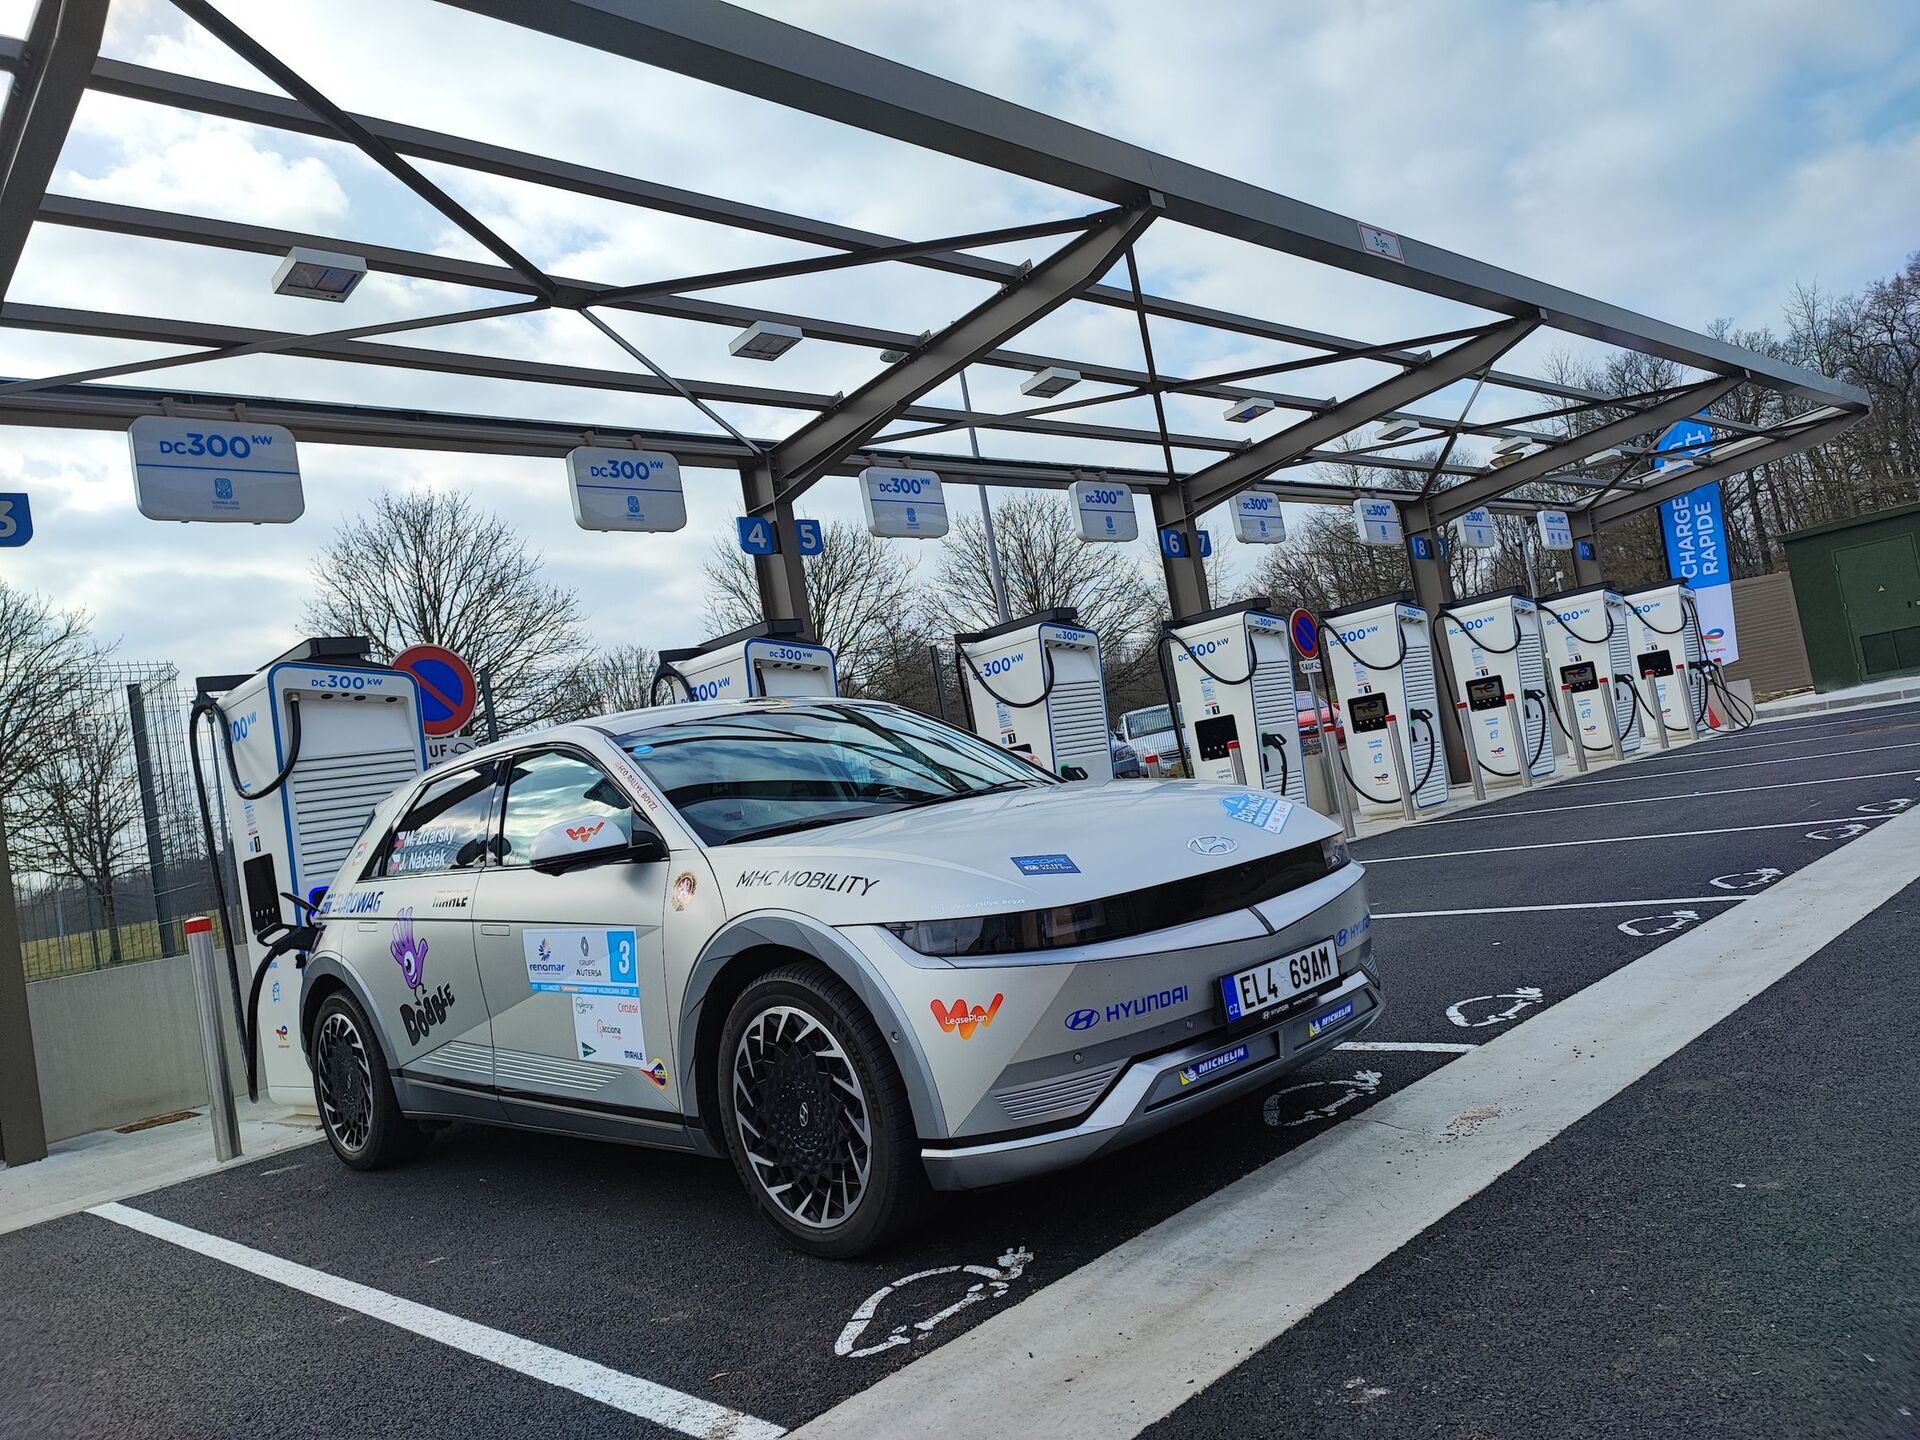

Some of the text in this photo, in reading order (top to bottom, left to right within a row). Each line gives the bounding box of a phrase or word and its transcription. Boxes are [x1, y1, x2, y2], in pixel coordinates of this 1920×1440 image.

[748, 522, 767, 549] 4
[800, 524, 817, 549] 5
[1169, 533, 1180, 553] 6
[1197, 535, 1205, 552] 7
[1672, 496, 1698, 579] CHARGE
[1694, 501, 1719, 577] RAPIDE
[1418, 541, 1426, 556] 8
[429, 744, 447, 757] UF
[736, 870, 880, 897] MHC MOBILITY
[530, 963, 565, 972] renomar
[618, 940, 631, 974] 3
[576, 969, 602, 977] AUTERSA
[1240, 946, 1332, 1010] EL4 69AM
[1106, 985, 1188, 1022] HYUNDAI
[1228, 1002, 1239, 1015] CZ
[1321, 1003, 1351, 1026] MICHELIN
[945, 1014, 988, 1025] LeasePlan
[1199, 1046, 1244, 1074] MICHELIN
